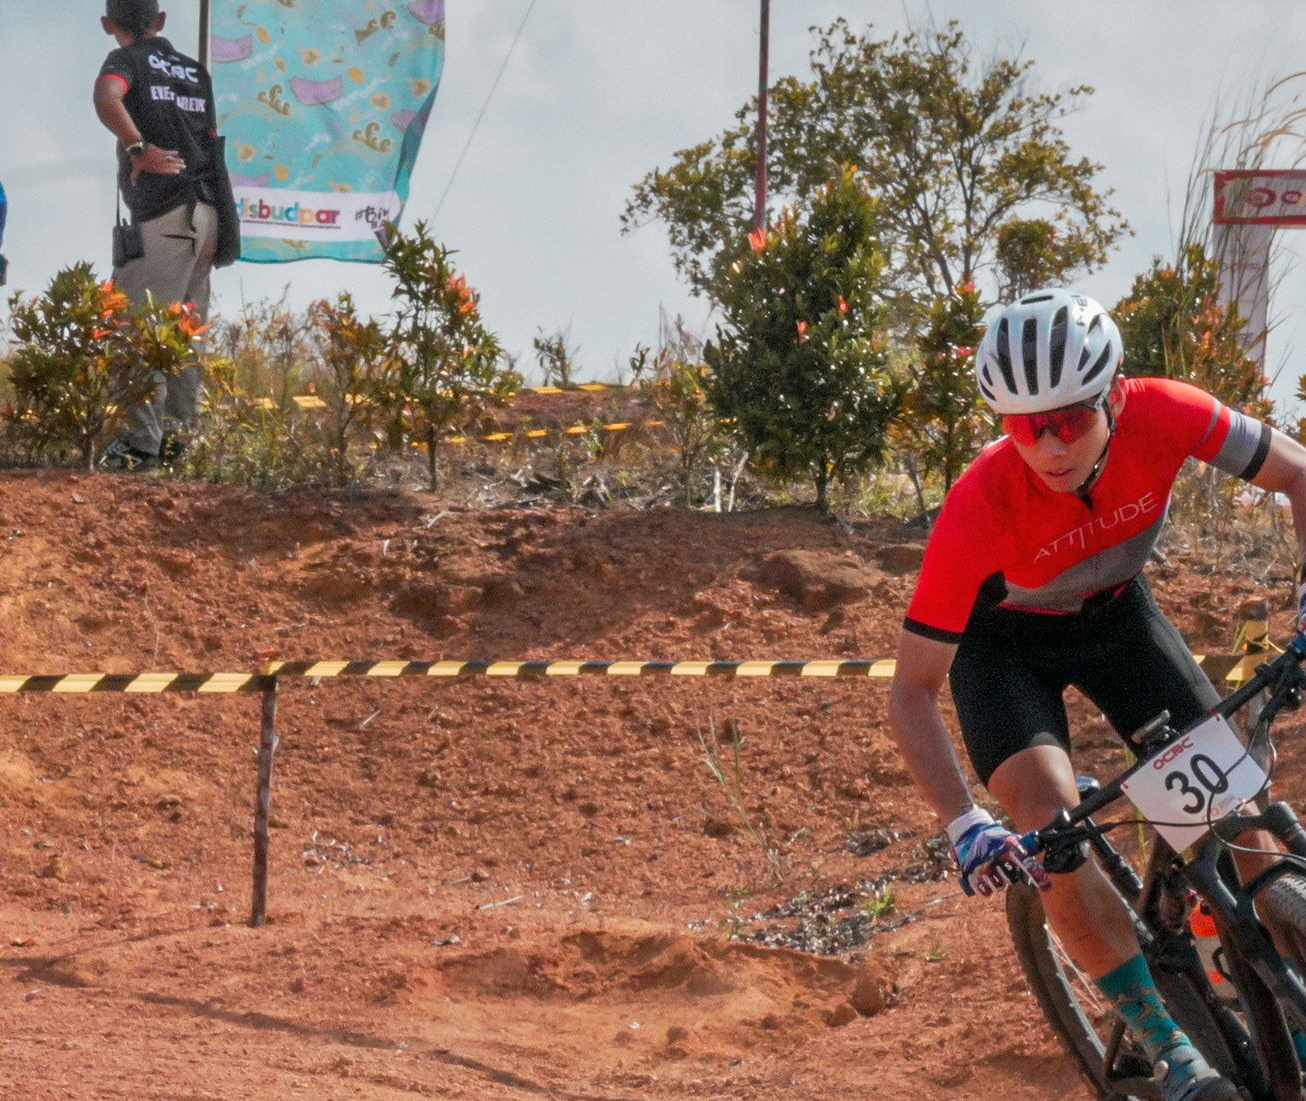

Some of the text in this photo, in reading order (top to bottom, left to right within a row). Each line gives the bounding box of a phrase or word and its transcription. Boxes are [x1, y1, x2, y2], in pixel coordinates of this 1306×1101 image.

[1033, 491, 1157, 564] ATTITUDE
[1152, 736, 1194, 770] OCBC
[1164, 753, 1229, 815] 30
